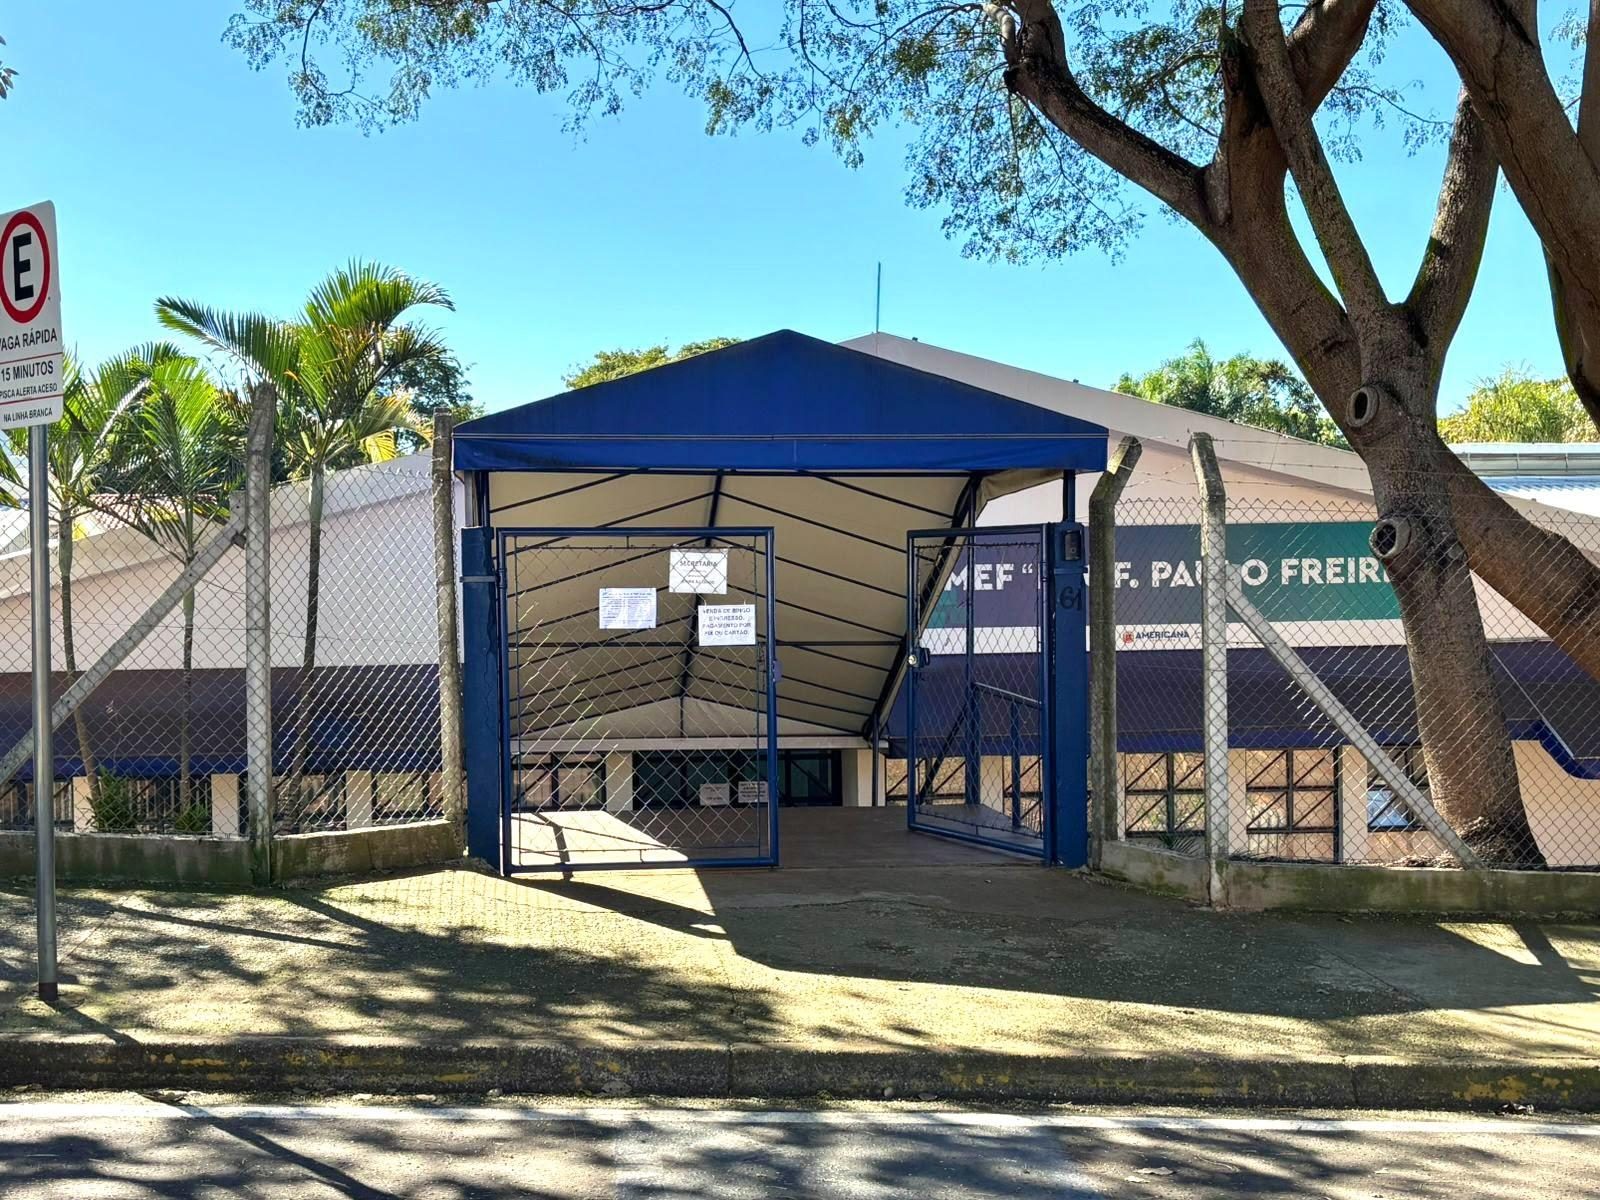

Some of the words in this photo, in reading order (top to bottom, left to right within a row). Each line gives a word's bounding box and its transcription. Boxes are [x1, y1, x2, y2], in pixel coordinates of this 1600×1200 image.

[13, 231, 34, 301] E
[0, 335, 21, 351] AGA
[22, 328, 58, 348] RÁPIDA
[1, 367, 11, 381] 15
[13, 360, 54, 380] MINUTOS
[16, 385, 37, 397] ALERTA
[38, 382, 58, 393] ACESO
[3, 413, 12, 422] NA
[12, 410, 29, 422] LINHA
[29, 407, 53, 419] BRANCA
[1151, 557, 1269, 588] PAO
[1136, 630, 1190, 639] AMERICANA
